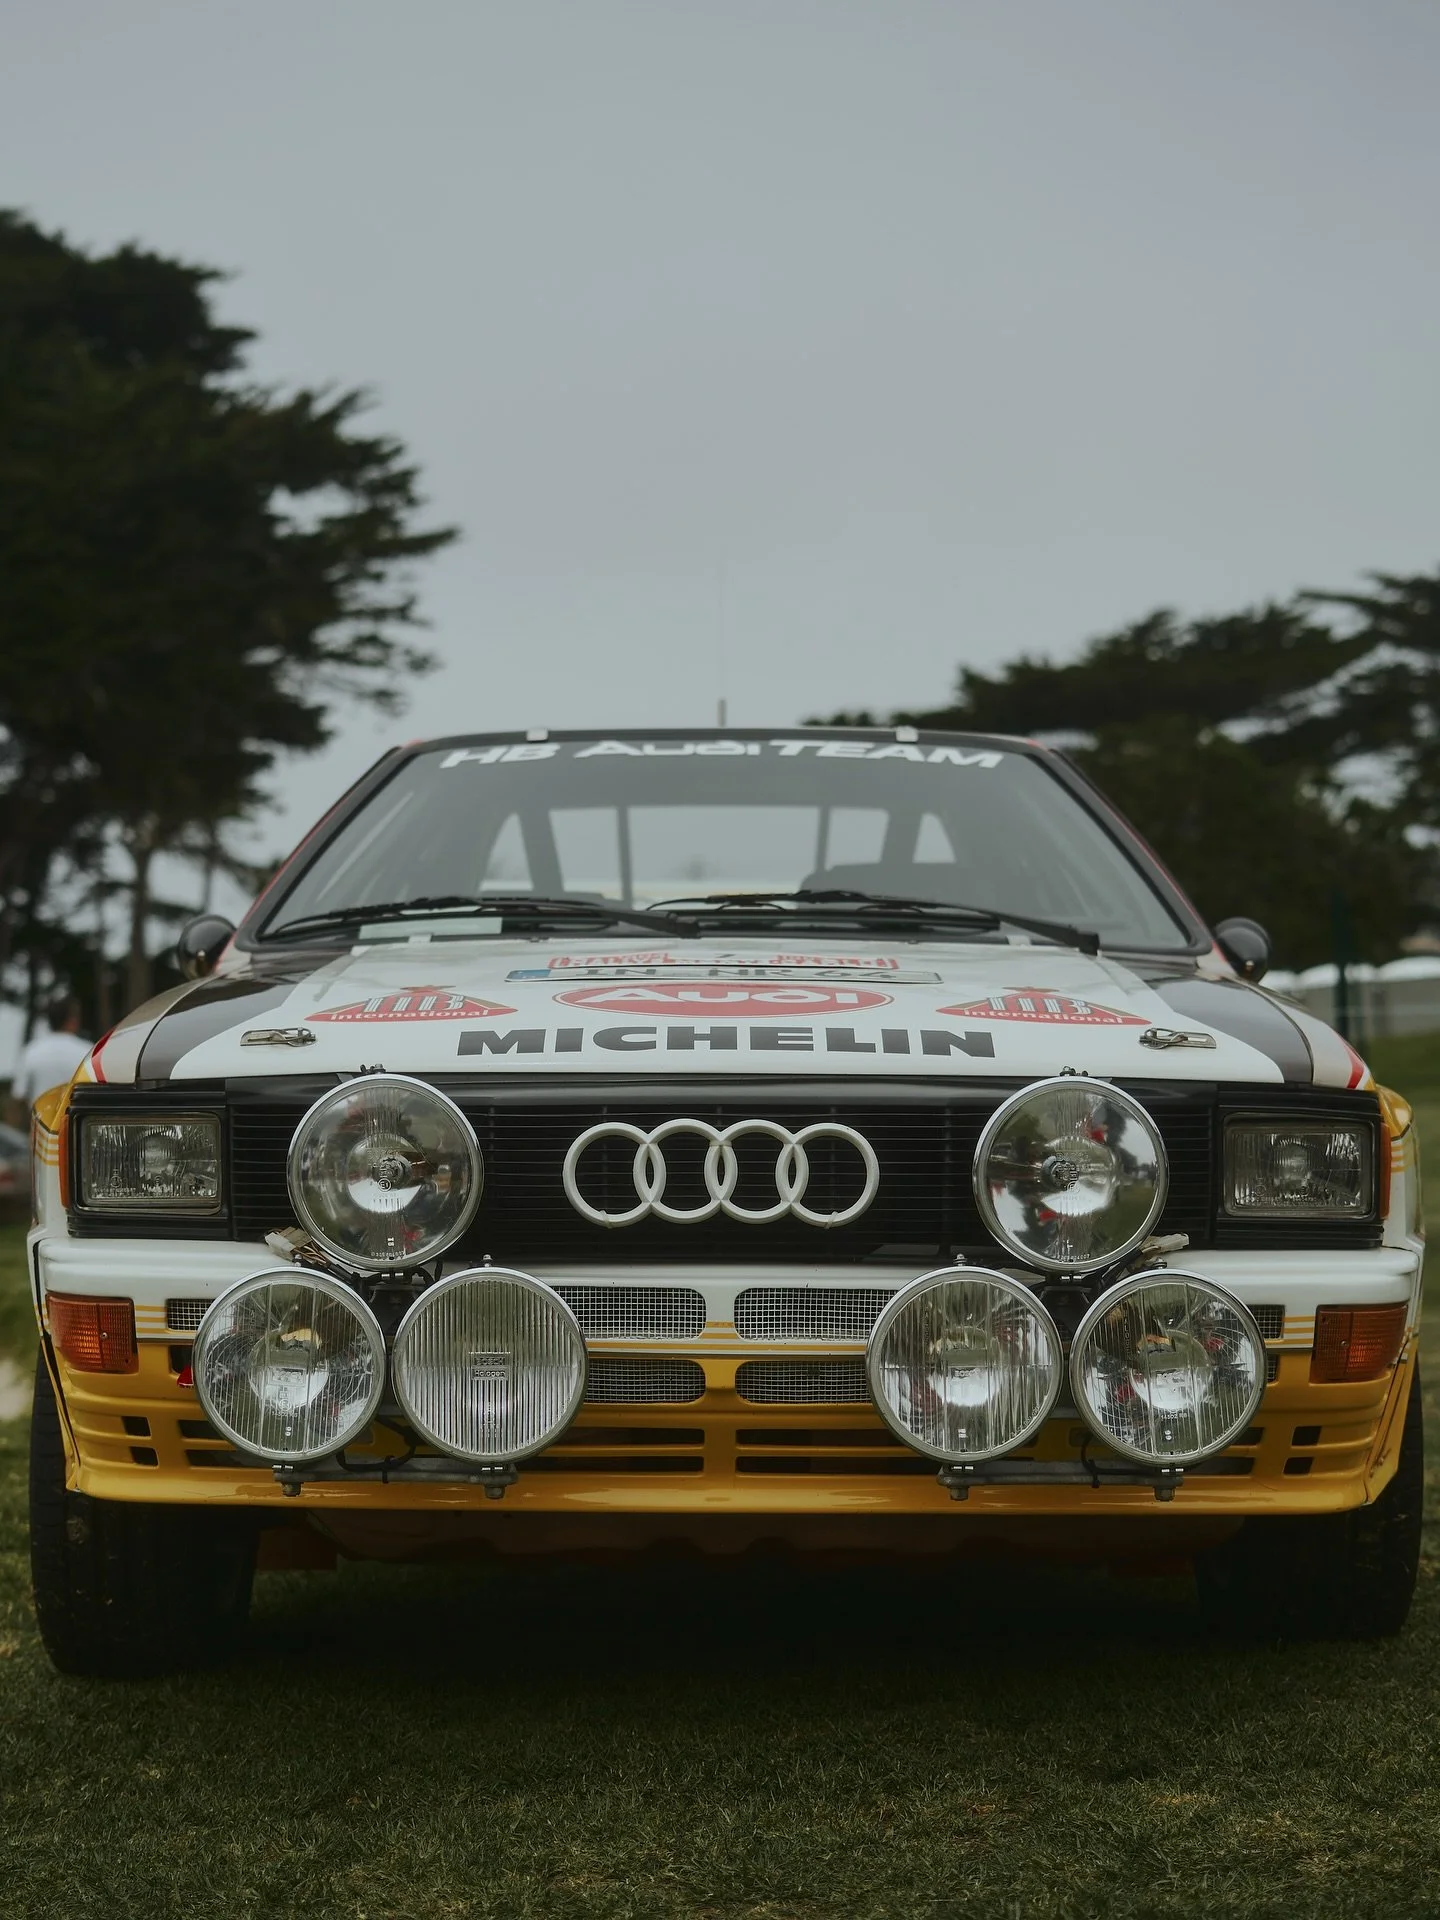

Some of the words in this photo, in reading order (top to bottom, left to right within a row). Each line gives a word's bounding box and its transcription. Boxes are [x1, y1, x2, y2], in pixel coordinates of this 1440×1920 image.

[440, 743, 560, 768] HB
[770, 740, 1004, 768] TEAM
[576, 968, 656, 977] IN
[706, 967, 793, 977] NR
[814, 970, 898, 979] 64
[457, 1026, 996, 1058] MICHELIN
